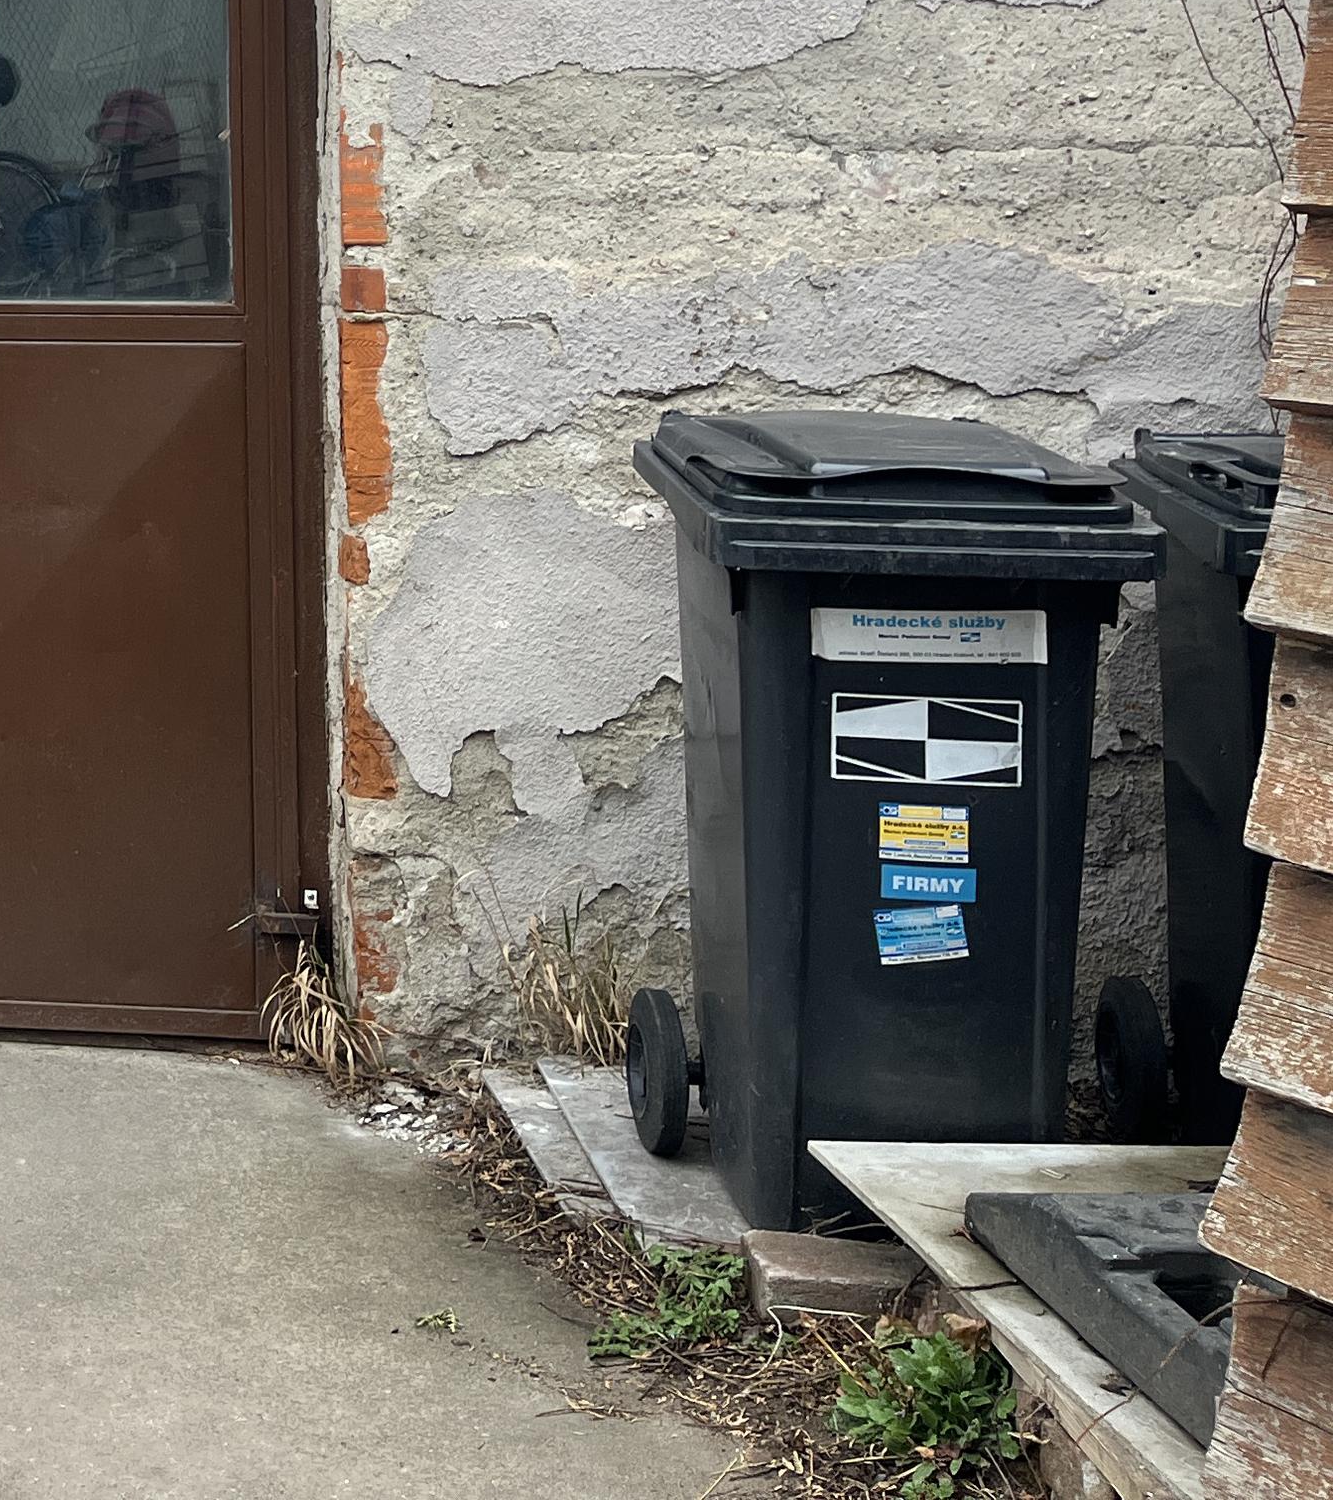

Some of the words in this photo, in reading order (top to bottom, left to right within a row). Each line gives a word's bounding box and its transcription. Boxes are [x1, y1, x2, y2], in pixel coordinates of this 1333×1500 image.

[852, 614, 942, 629] Hradecké
[948, 614, 1006, 631] služby
[891, 875, 965, 894] FIRMY
